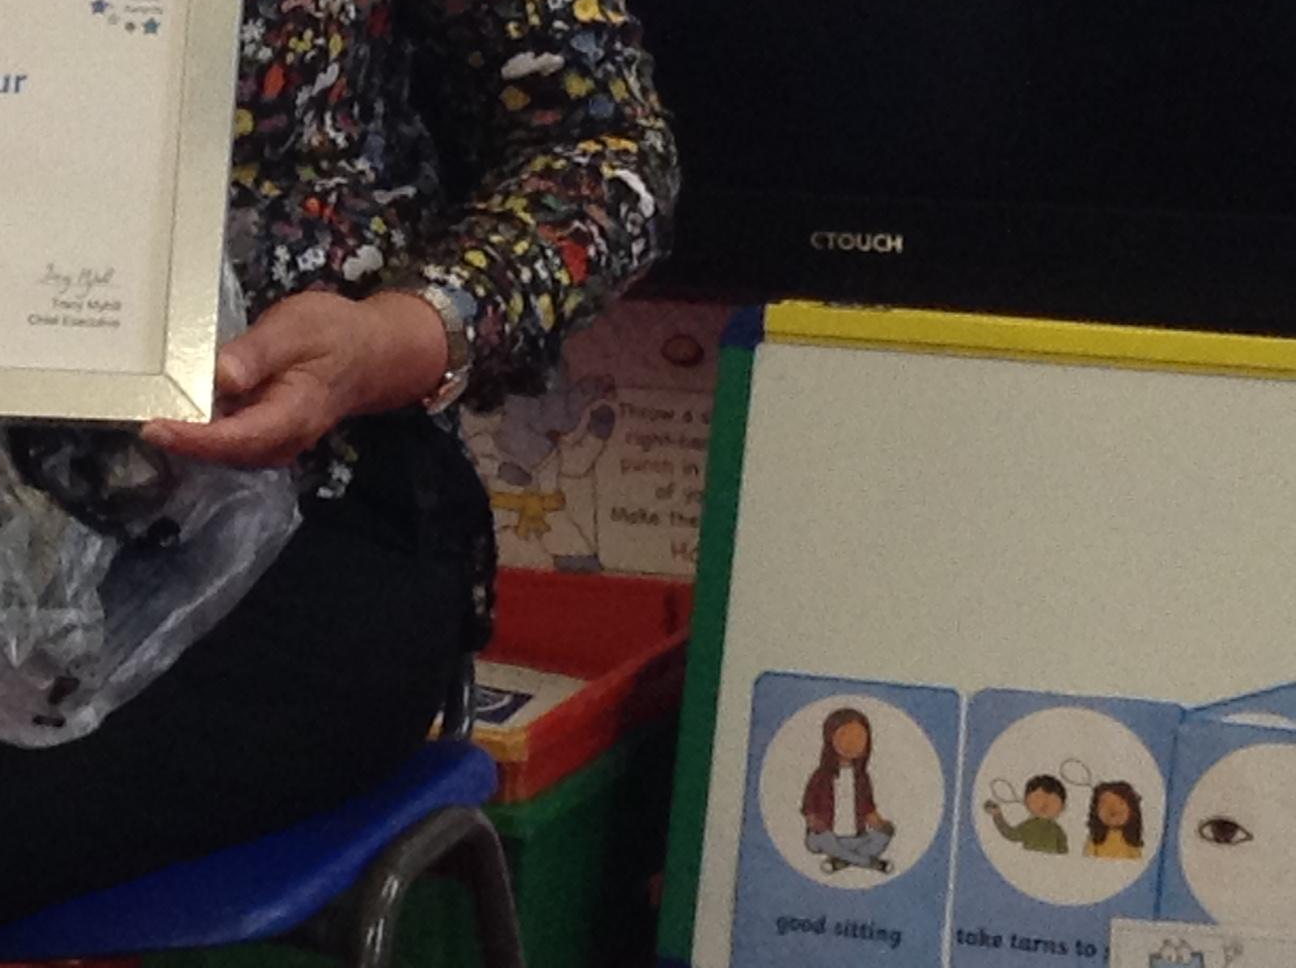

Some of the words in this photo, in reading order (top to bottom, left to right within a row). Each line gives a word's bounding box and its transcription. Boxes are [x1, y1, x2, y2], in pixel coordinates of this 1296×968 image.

[810, 232, 904, 254] CTOUCH
[775, 914, 827, 937] good
[833, 919, 902, 950] sitting
[955, 927, 1003, 950] take
[1074, 938, 1099, 959] to
